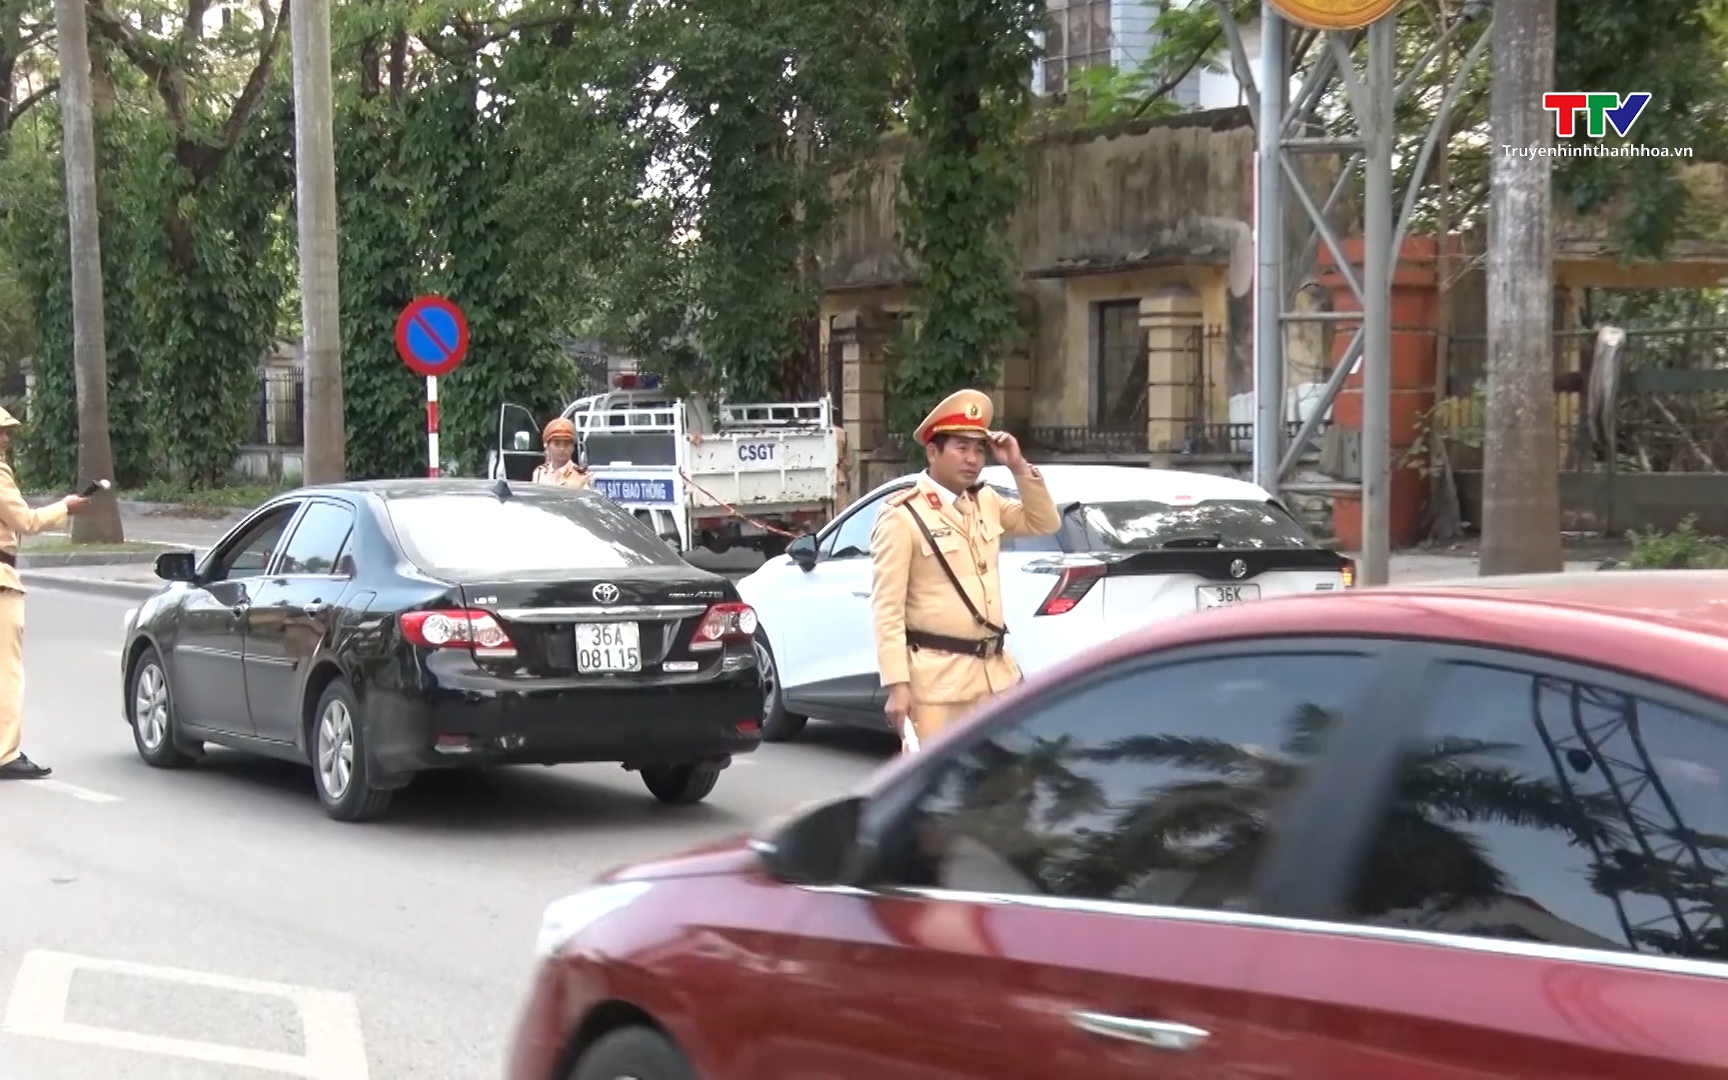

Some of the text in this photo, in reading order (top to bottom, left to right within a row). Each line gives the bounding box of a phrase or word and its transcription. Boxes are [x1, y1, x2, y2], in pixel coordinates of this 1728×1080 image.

[738, 443, 775, 461] CSGT
[622, 481, 640, 499] GIAO
[1216, 587, 1242, 602] 36K
[591, 626, 624, 646] 36A
[580, 648, 638, 669] 081.15
